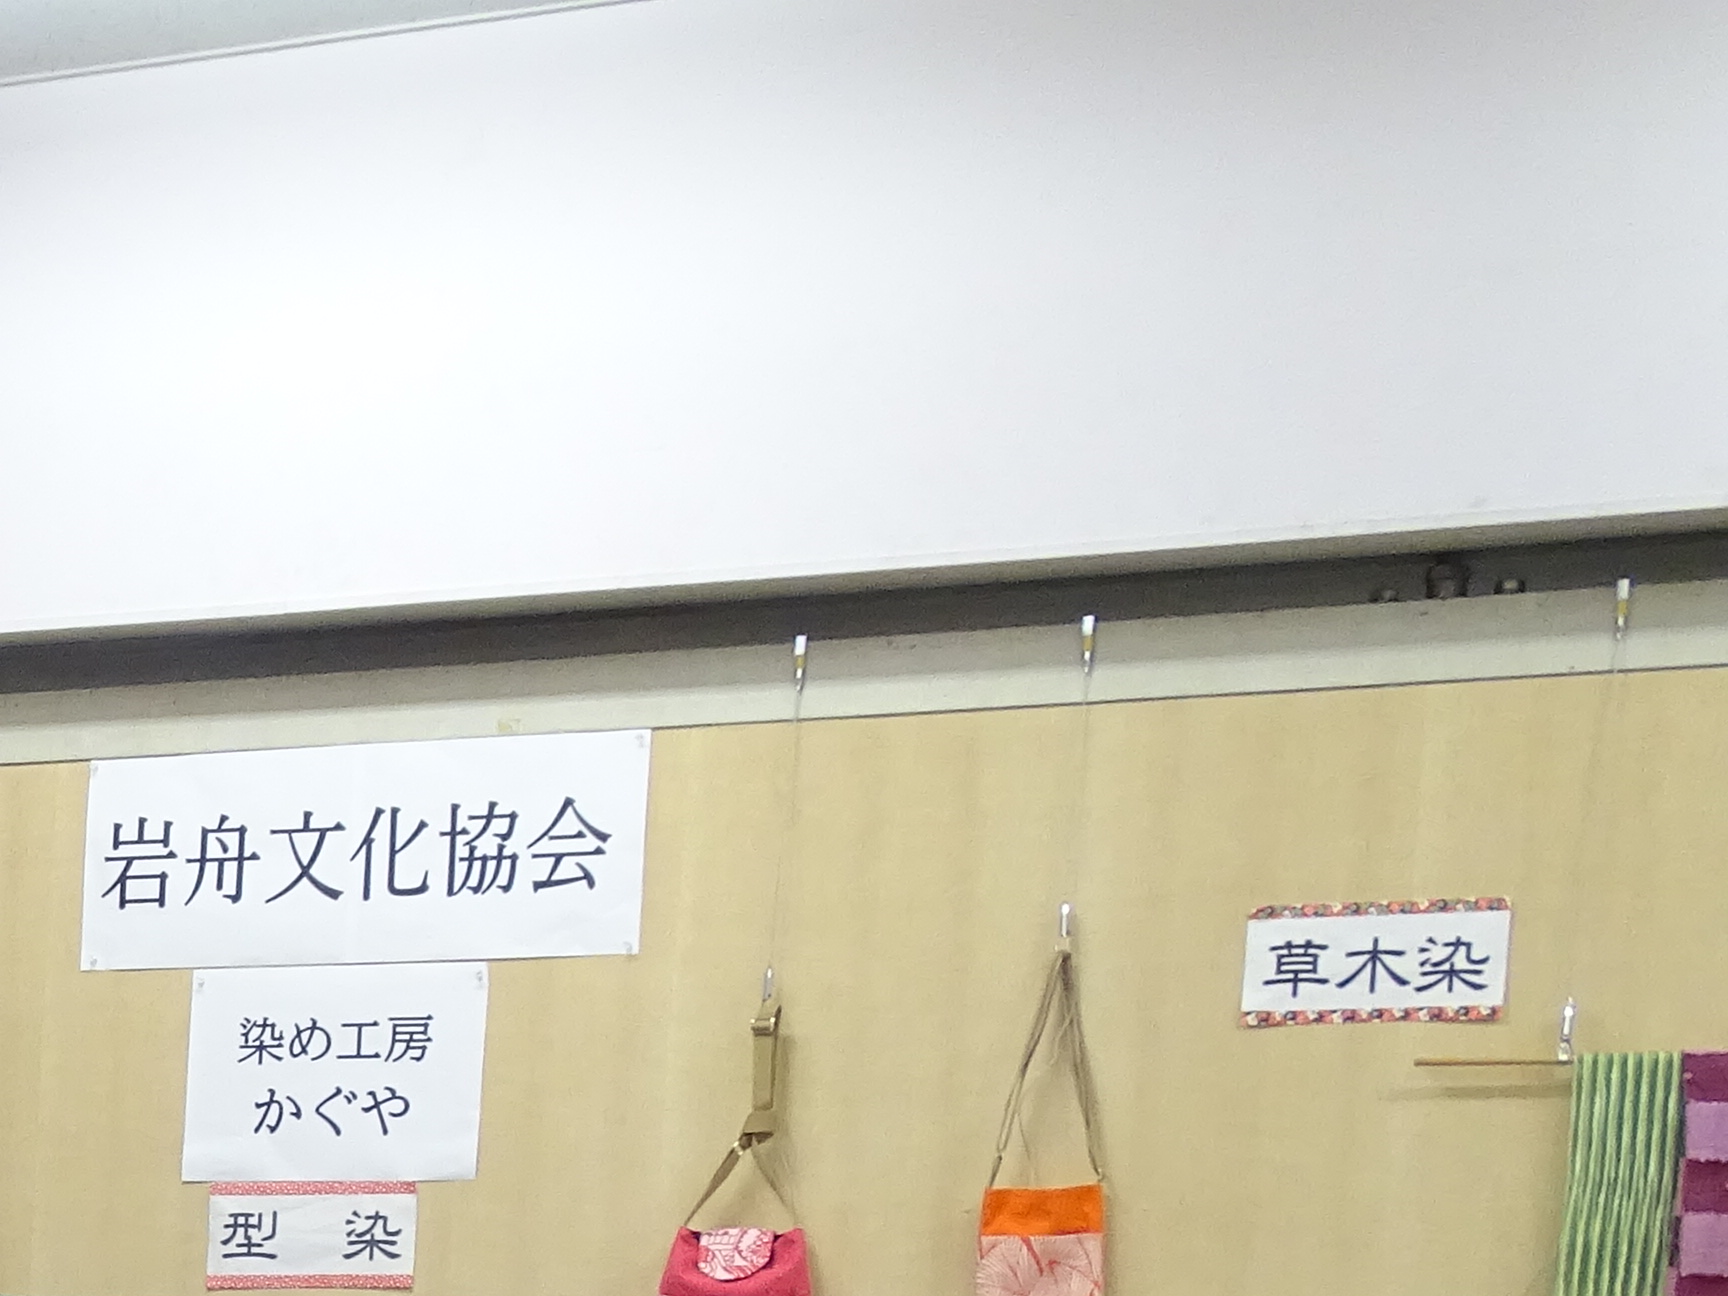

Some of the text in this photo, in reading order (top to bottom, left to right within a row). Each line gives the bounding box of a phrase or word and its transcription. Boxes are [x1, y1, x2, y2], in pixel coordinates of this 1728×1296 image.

[102, 796, 613, 911] 岩舟文化協会
[1262, 935, 1491, 999] 草木染
[236, 1015, 434, 1066] 染め工房
[253, 1085, 411, 1137] かぐや
[220, 1210, 403, 1262] 型 染
